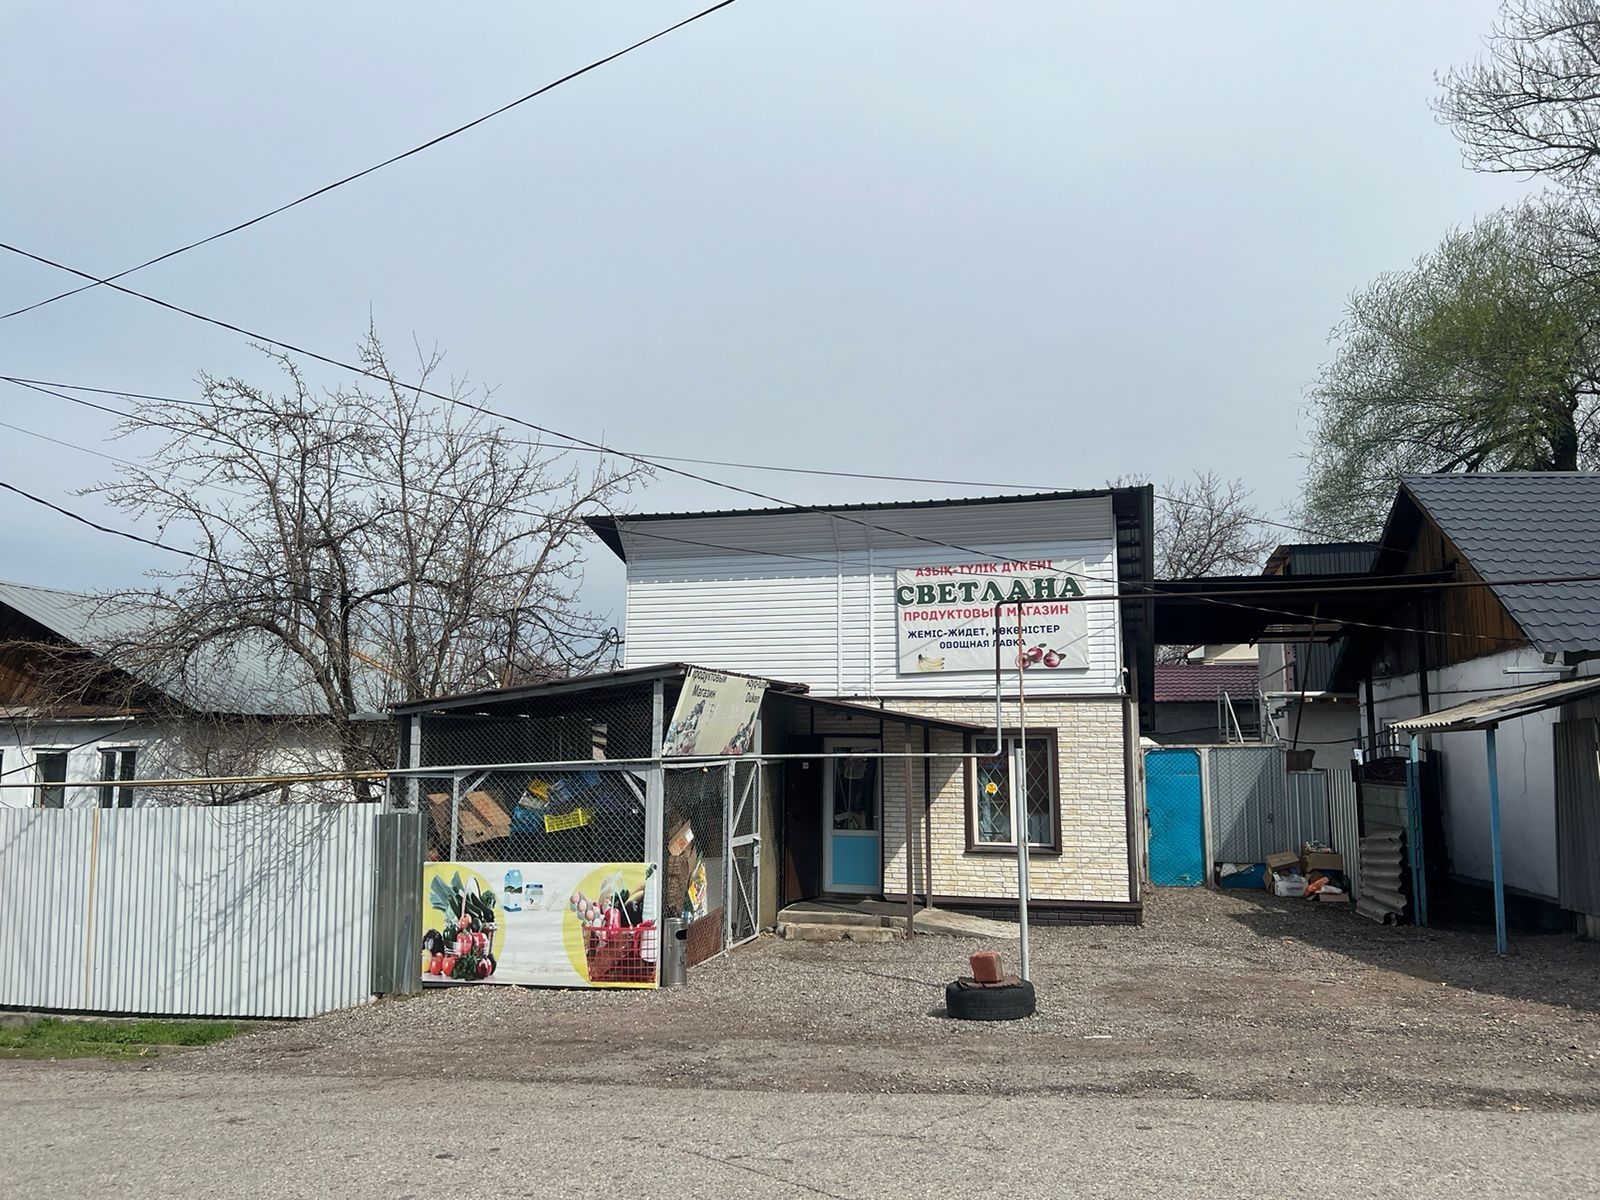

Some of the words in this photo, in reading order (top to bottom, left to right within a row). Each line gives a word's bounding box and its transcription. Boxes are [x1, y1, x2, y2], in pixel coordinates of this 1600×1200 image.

[897, 576, 1085, 606] СВЕТЛАНА
[1007, 604, 1069, 617] МАГАЗИН
[939, 640, 990, 650] ОВОЩНАЯ
[992, 638, 1027, 649] ЛАВКА
